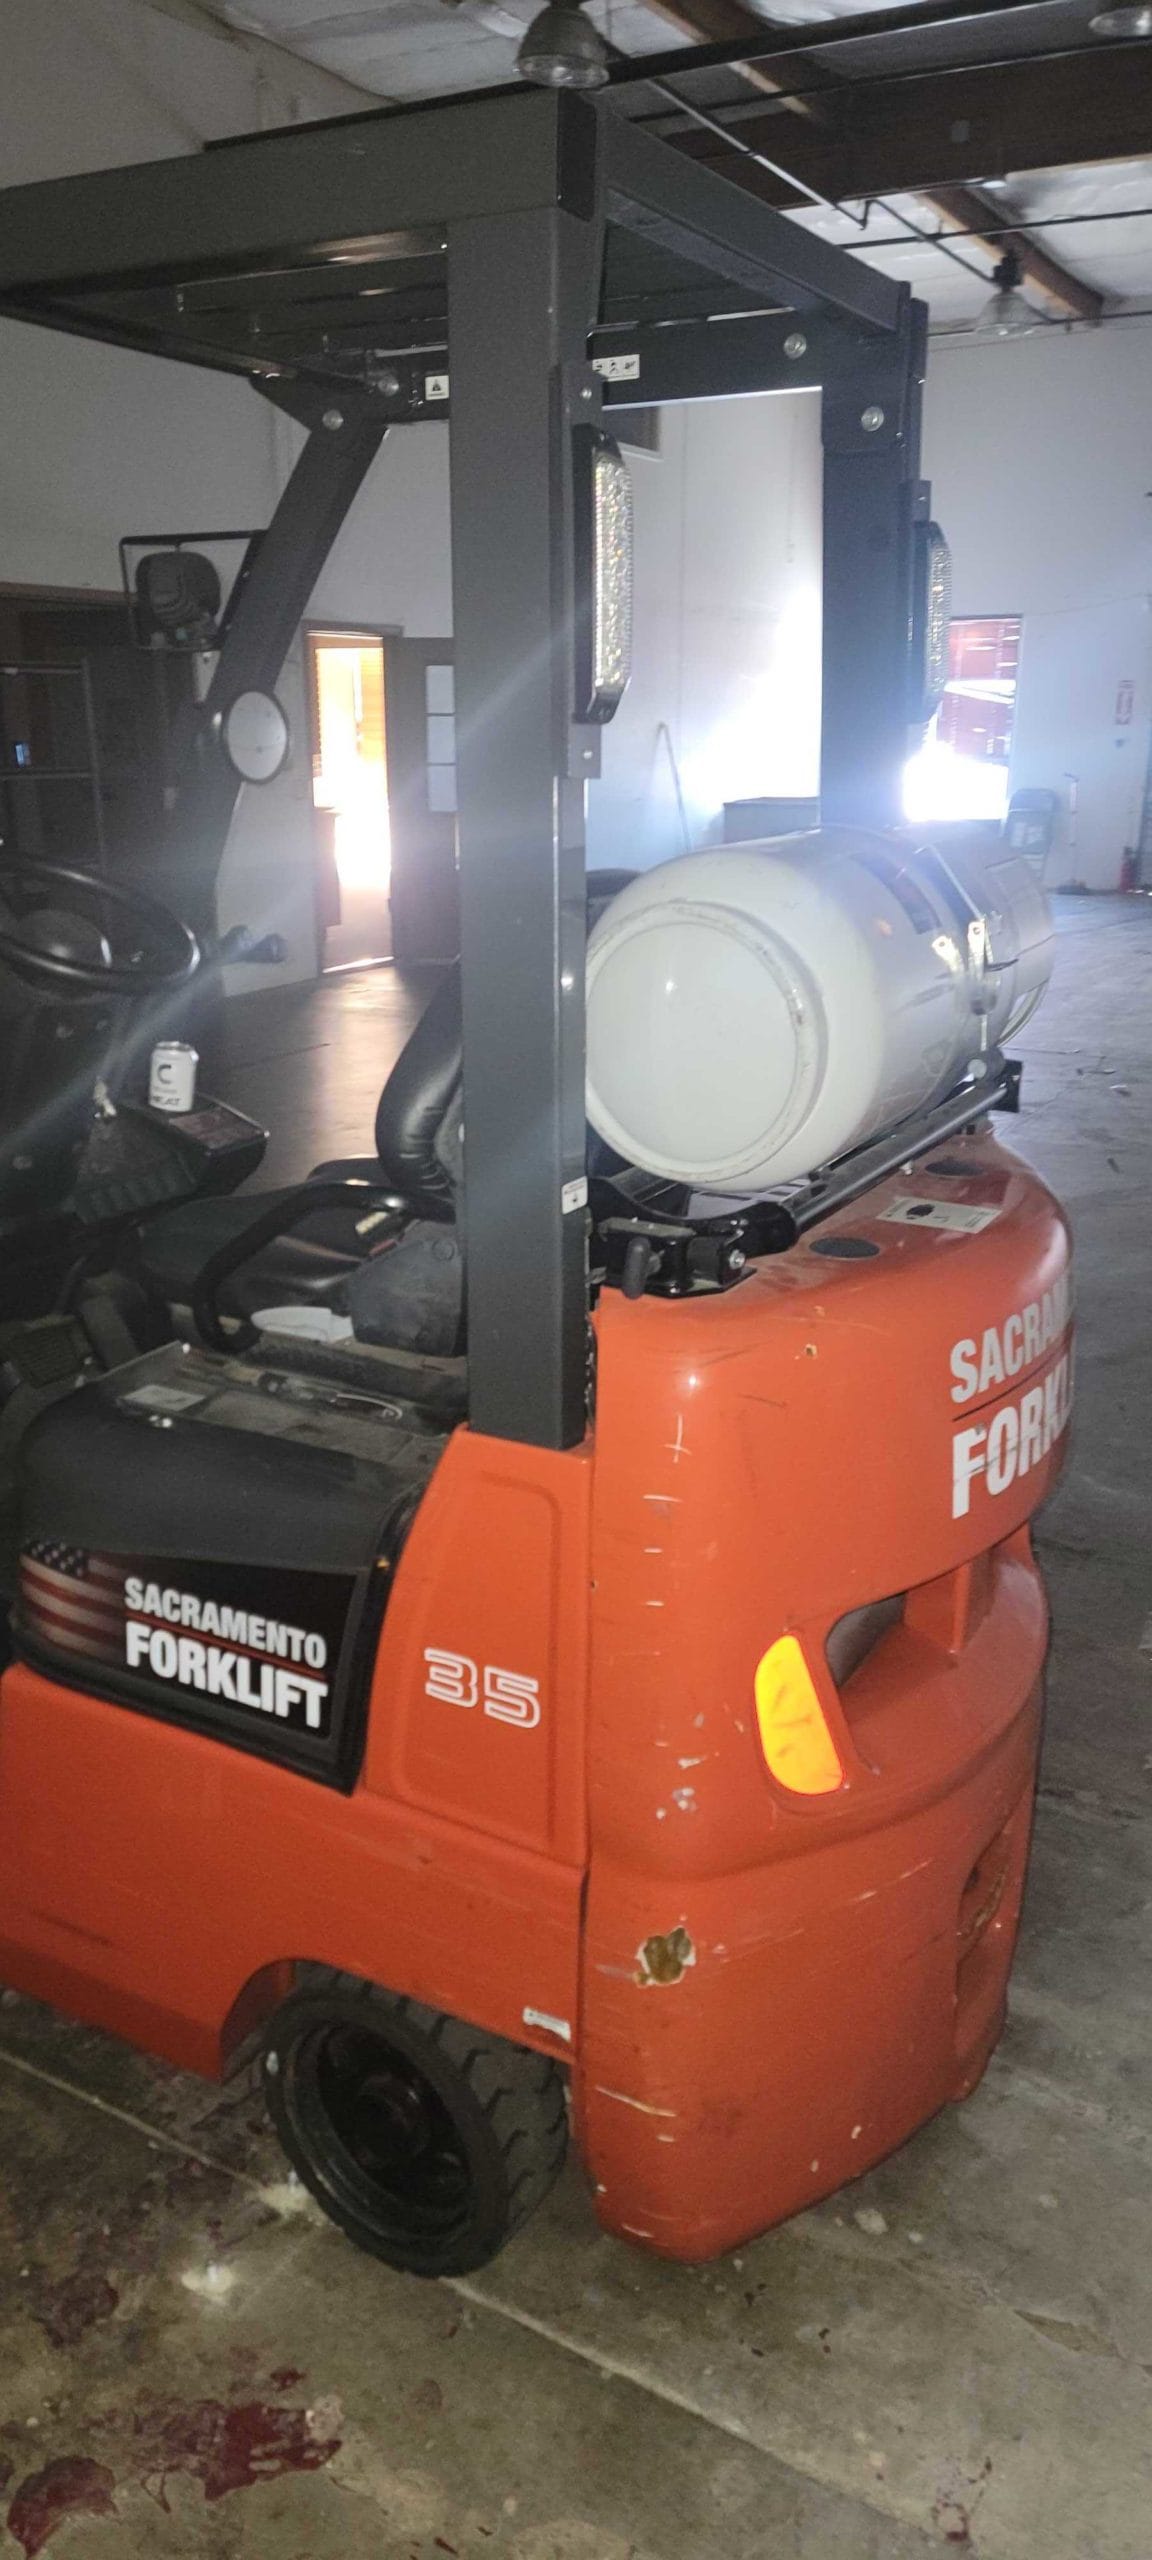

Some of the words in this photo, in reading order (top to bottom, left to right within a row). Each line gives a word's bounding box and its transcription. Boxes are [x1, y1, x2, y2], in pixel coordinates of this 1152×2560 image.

[157, 1064, 172, 1084] C
[124, 1577, 327, 1668] SACRAMENTO
[126, 1621, 328, 1728] FORKLIFT
[424, 1647, 541, 1728] 35
